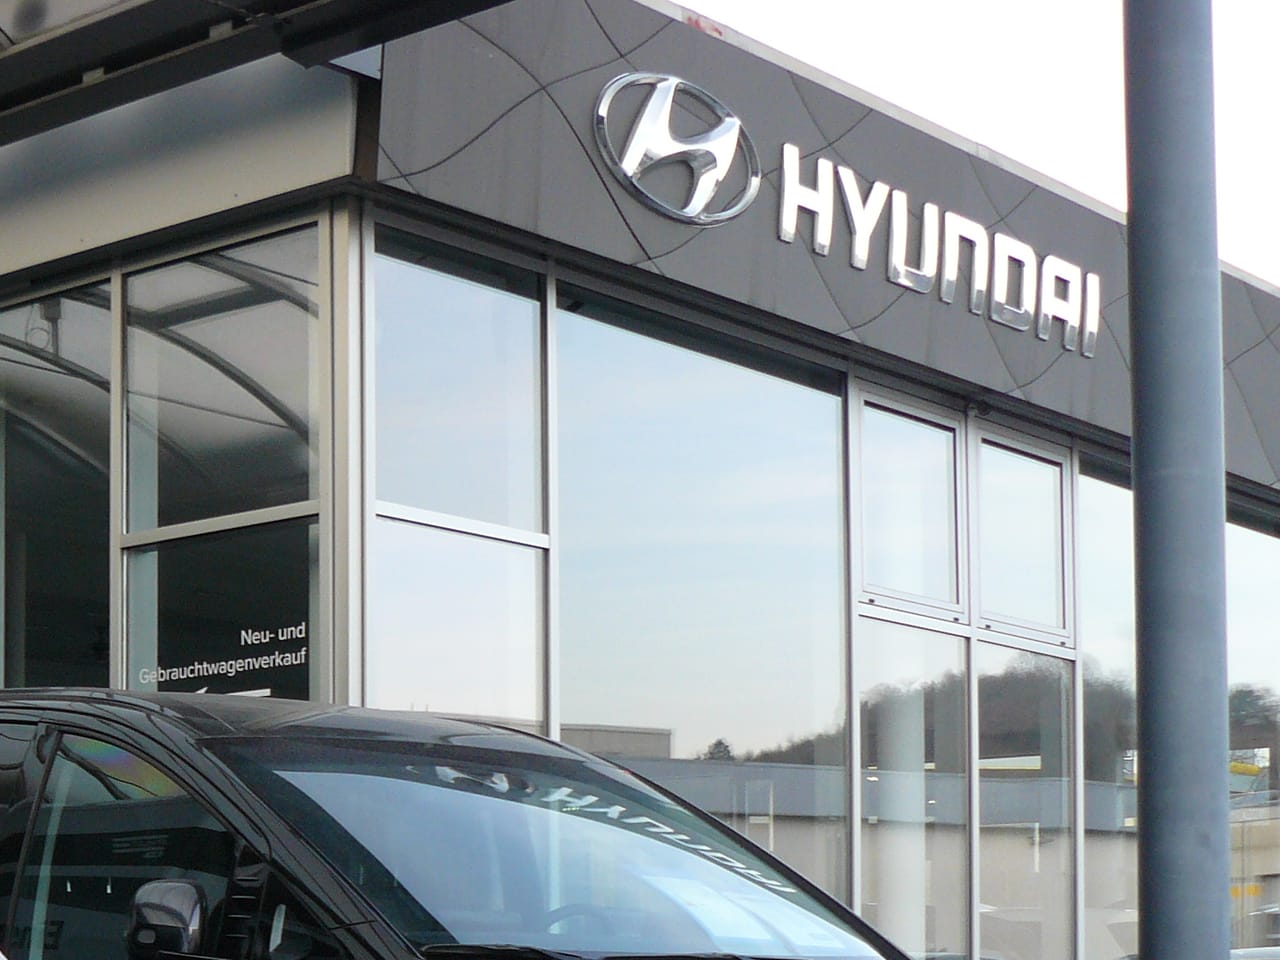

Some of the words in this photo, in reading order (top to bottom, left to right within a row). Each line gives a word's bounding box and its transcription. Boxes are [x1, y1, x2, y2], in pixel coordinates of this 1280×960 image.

[778, 143, 1101, 358] HYUNDAI
[240, 629, 274, 646] Neu-
[278, 622, 306, 641] und
[139, 647, 307, 684] Gebrauchtwagenverkauf
